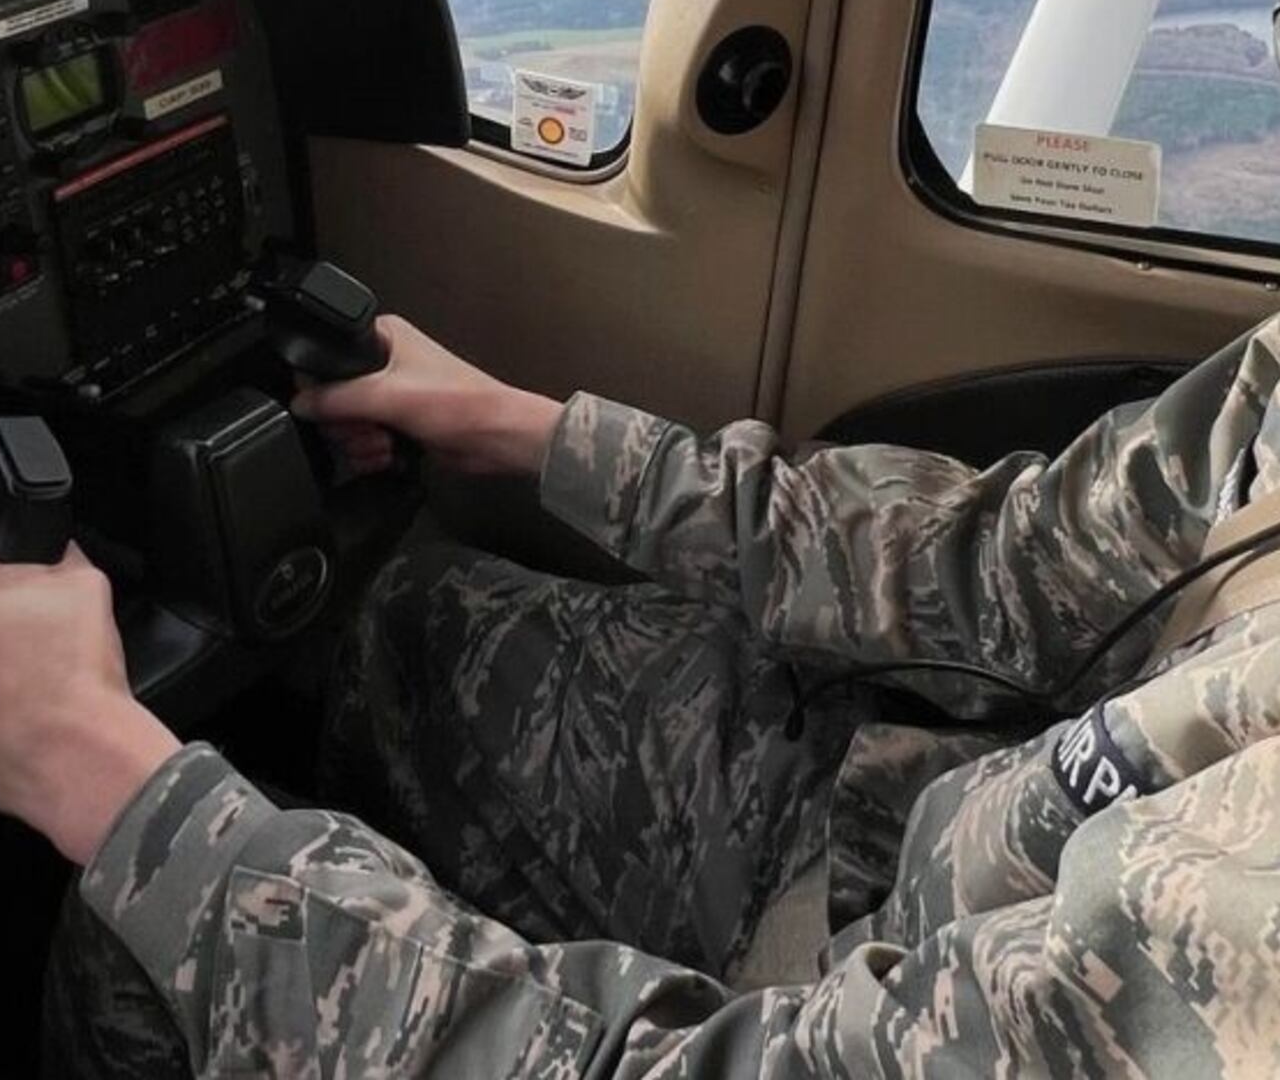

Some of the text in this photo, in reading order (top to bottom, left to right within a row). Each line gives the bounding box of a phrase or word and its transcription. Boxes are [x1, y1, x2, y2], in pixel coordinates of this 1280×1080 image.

[1035, 132, 1090, 153] PLEASE
[1011, 154, 1045, 167] DOOR
[1046, 158, 1091, 174] GENTLY
[1092, 162, 1108, 177] TO
[1109, 166, 1144, 182] CLOSE
